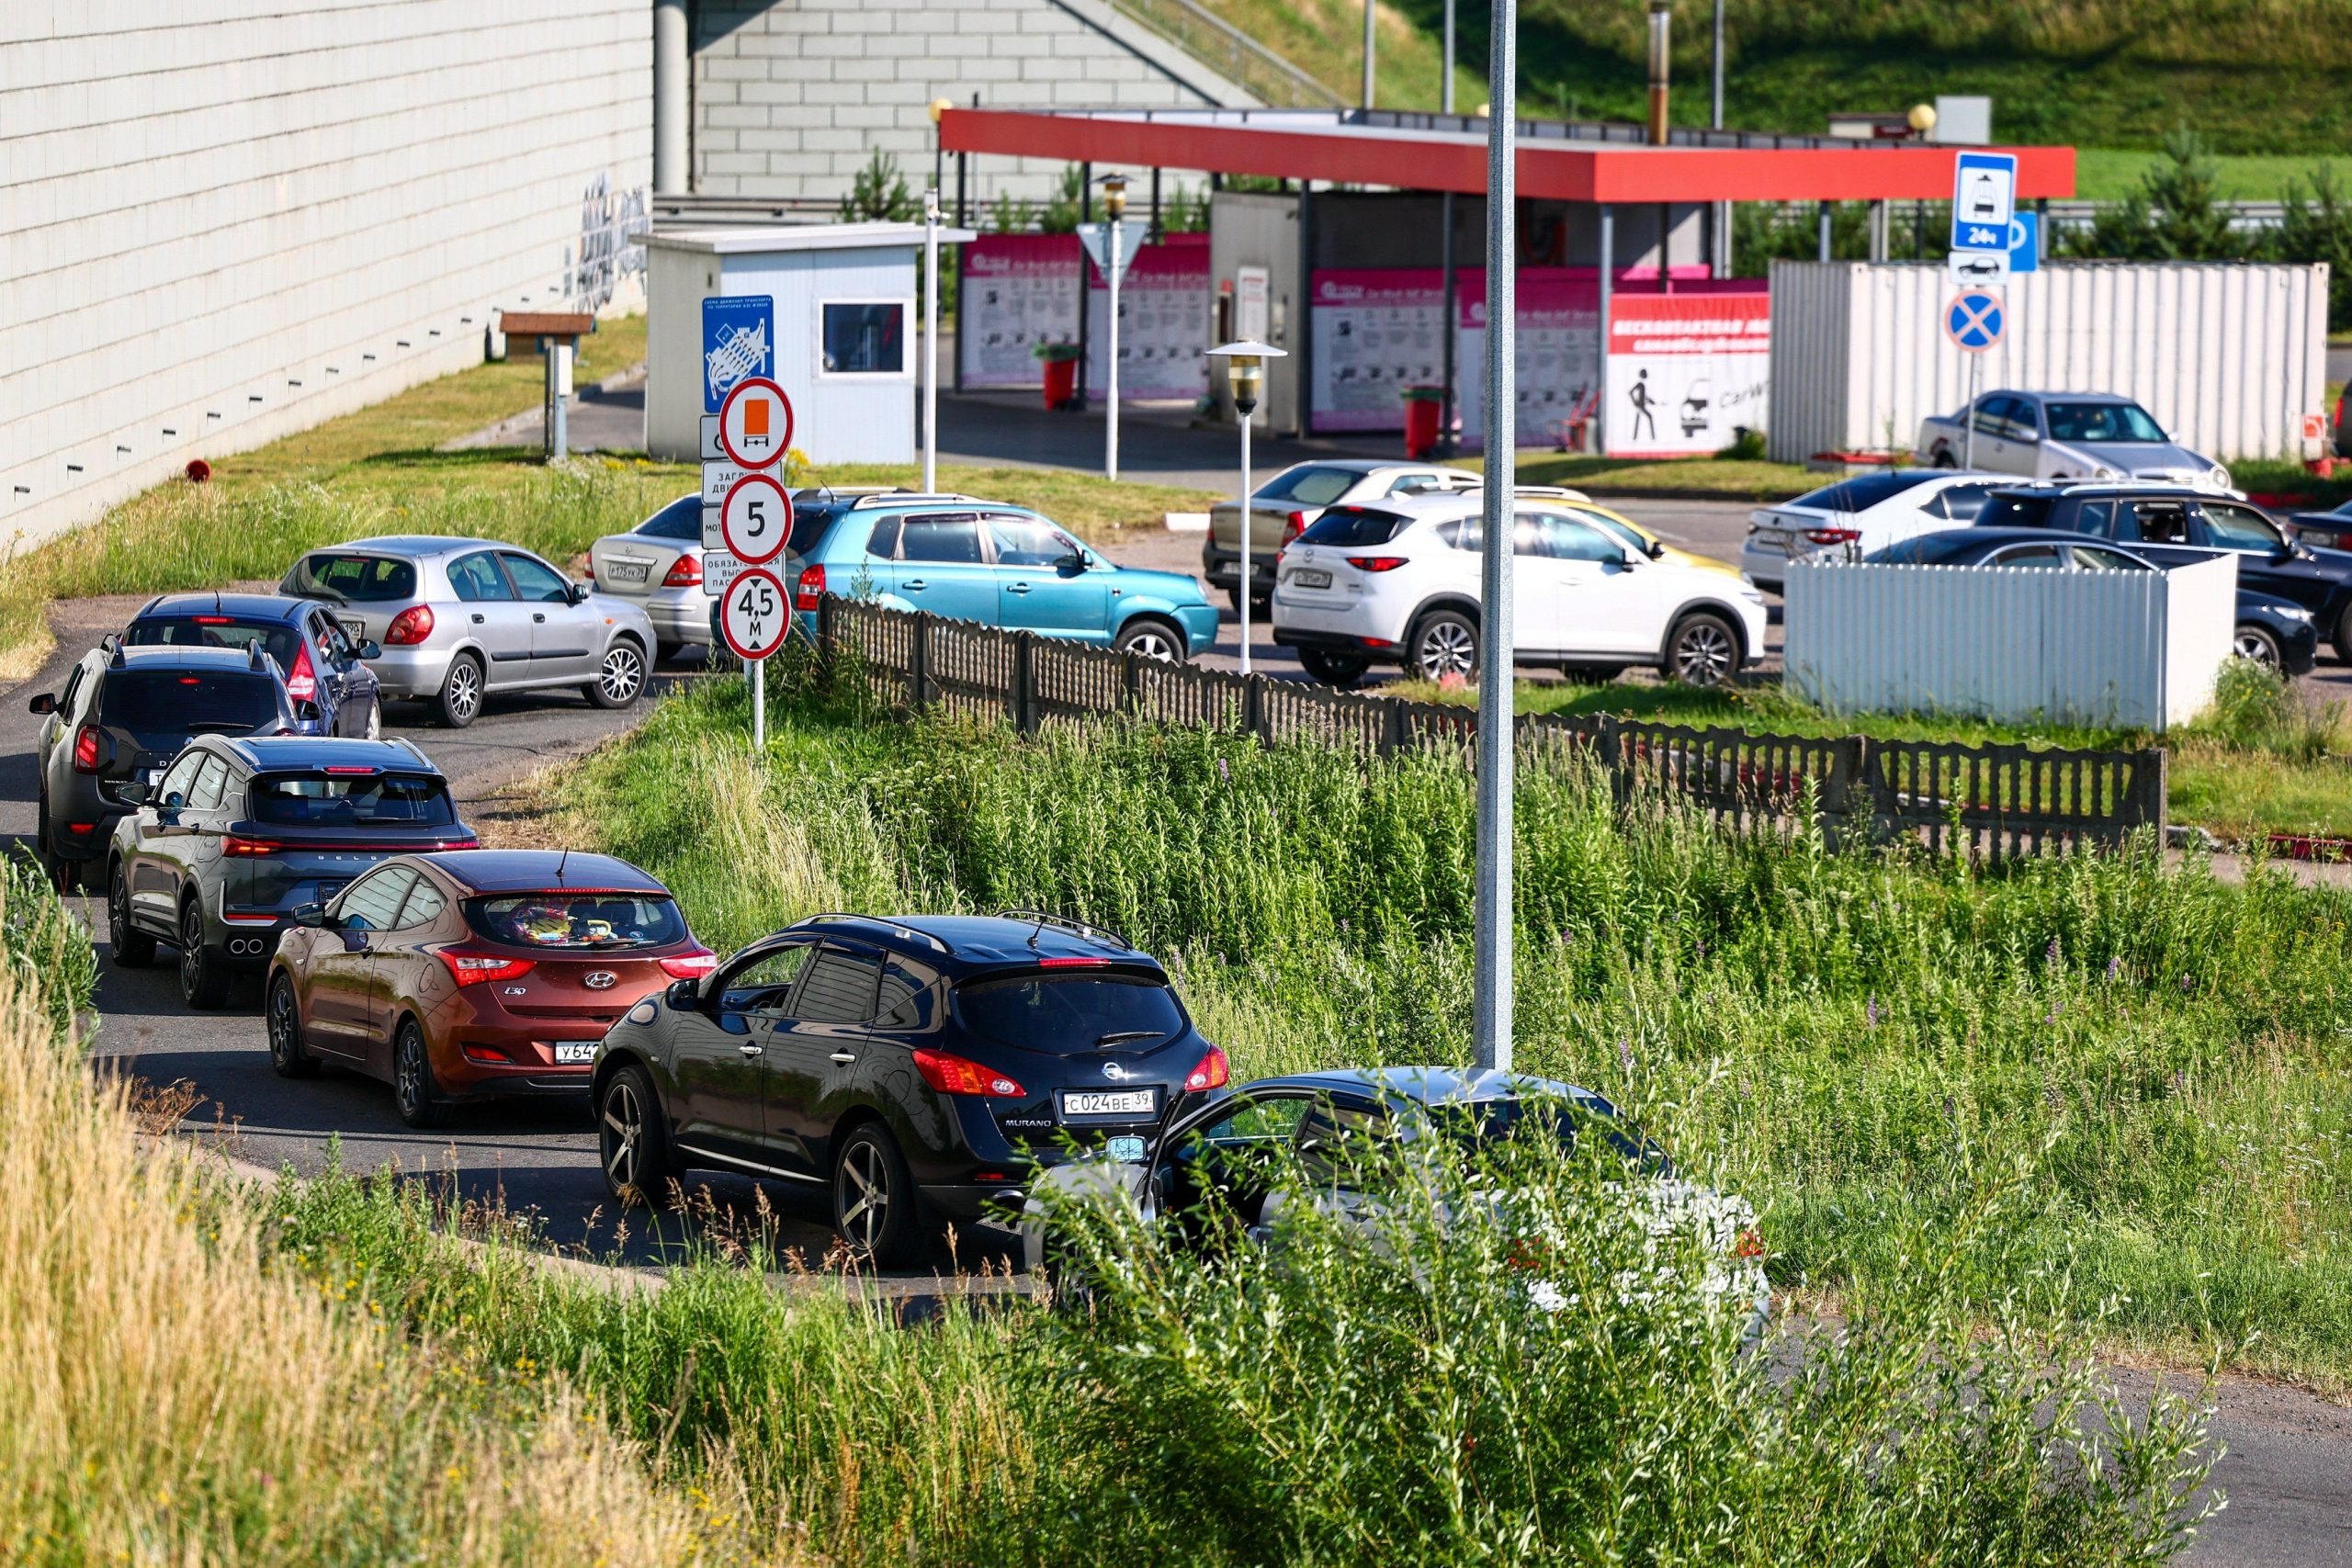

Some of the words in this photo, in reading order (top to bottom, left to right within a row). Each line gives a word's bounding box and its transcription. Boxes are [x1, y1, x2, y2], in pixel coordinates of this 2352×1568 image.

[747, 502, 765, 537] 5
[738, 589, 774, 621] 4,5
[1134, 1093, 1148, 1106] 39
[1005, 1120, 1052, 1128] MURANO
